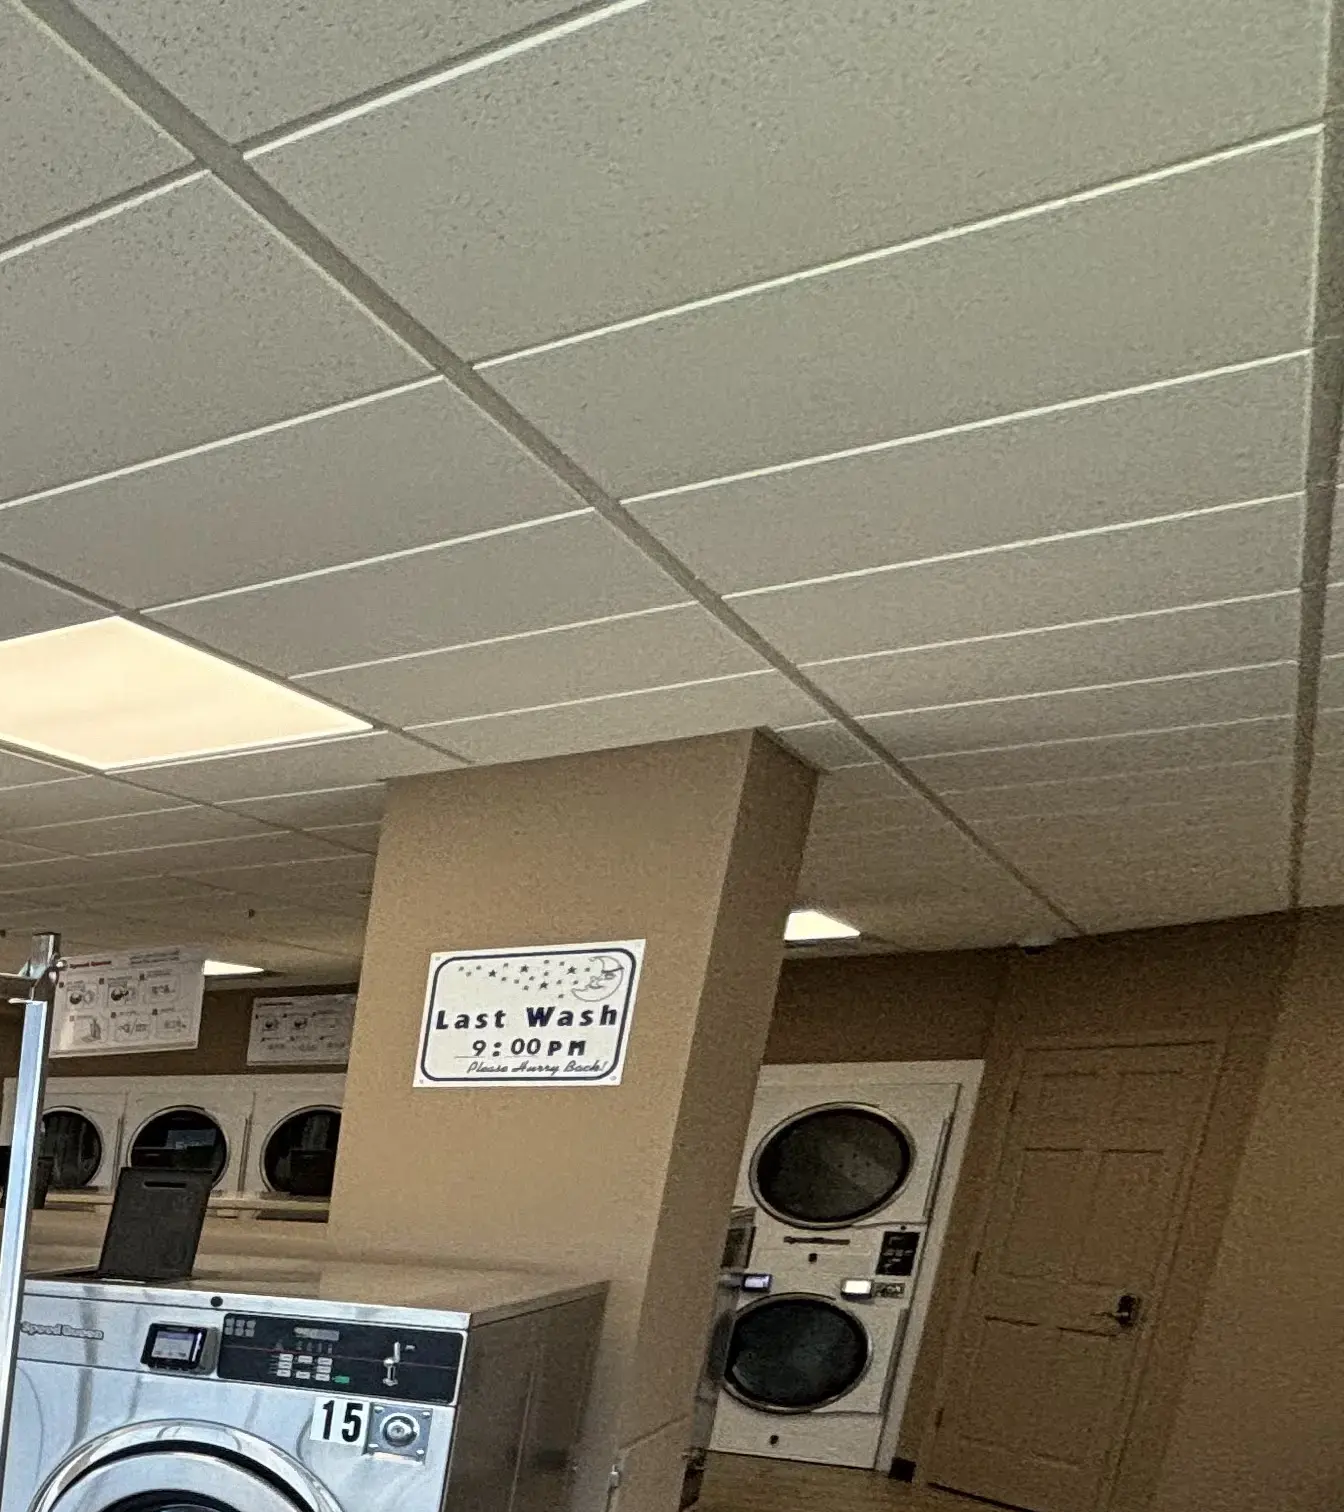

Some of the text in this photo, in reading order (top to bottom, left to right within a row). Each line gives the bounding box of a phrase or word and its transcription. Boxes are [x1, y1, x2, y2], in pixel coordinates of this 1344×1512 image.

[436, 1004, 617, 1030] Last Wash
[466, 1059, 608, 1076] Please Hurry Back!
[20, 1320, 104, 1340] Speed Queen
[322, 1399, 364, 1442] 15
